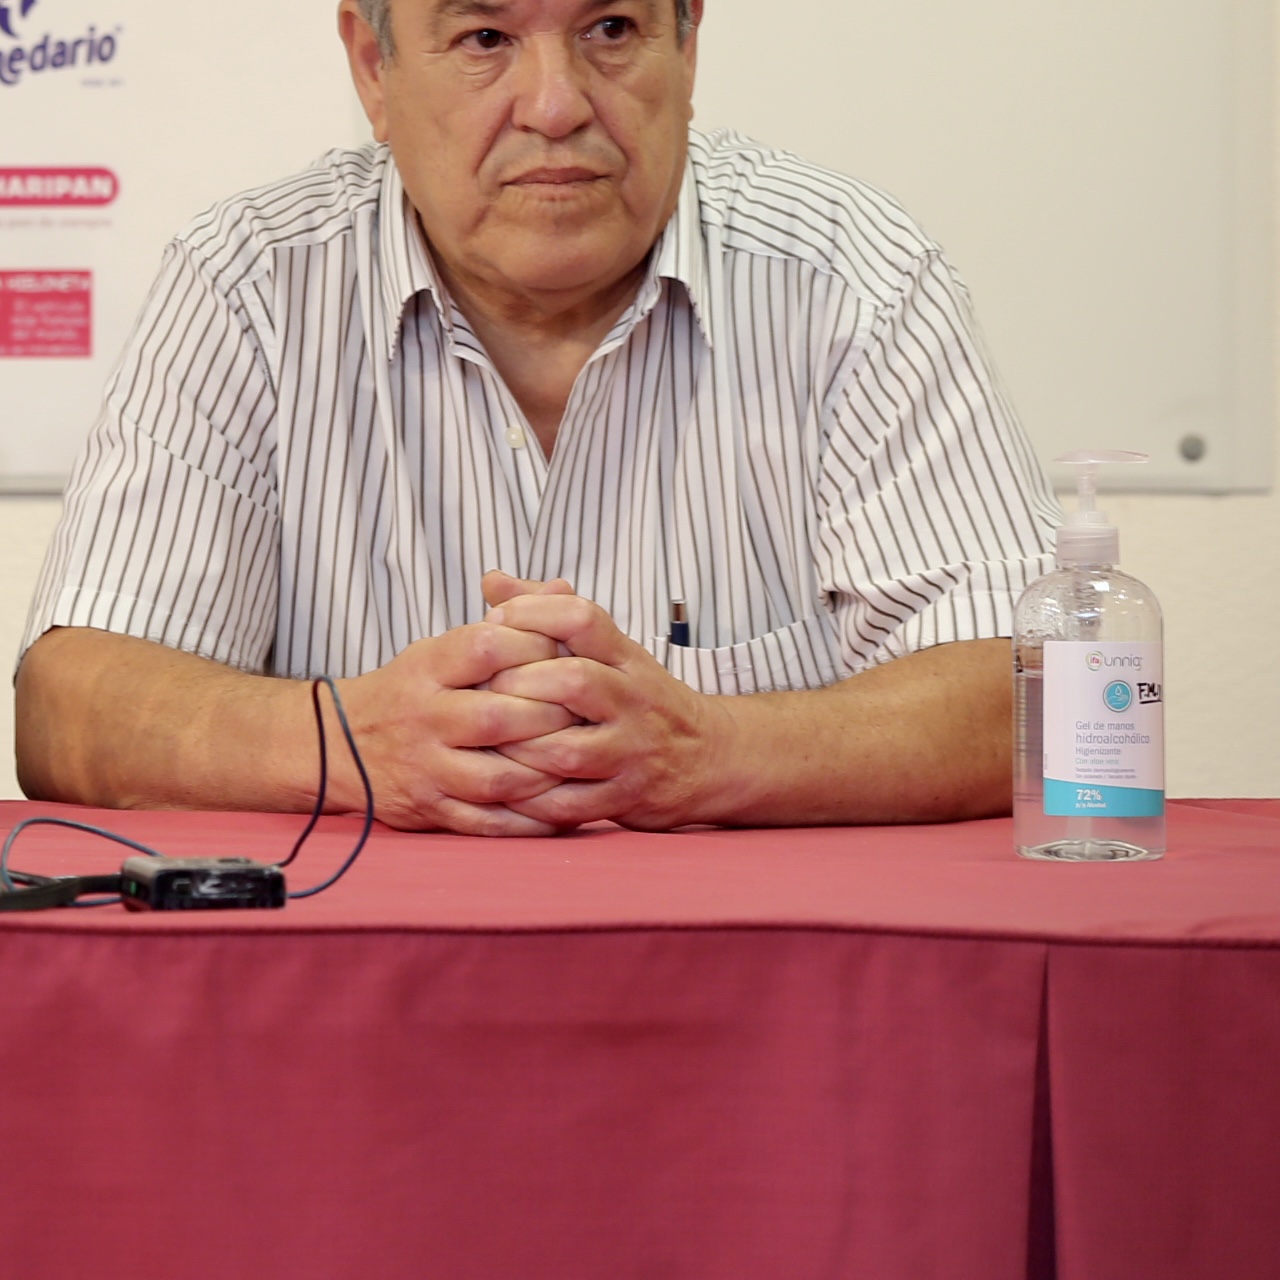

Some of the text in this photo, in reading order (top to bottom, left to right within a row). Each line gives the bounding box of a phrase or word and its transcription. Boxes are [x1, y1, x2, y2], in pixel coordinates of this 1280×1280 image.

[1075, 720, 1135, 731] Gel de manos
[1075, 732, 1150, 744] hidroalcohólico
[1075, 746, 1121, 756] Higienizante
[1075, 788, 1103, 801] 72%
